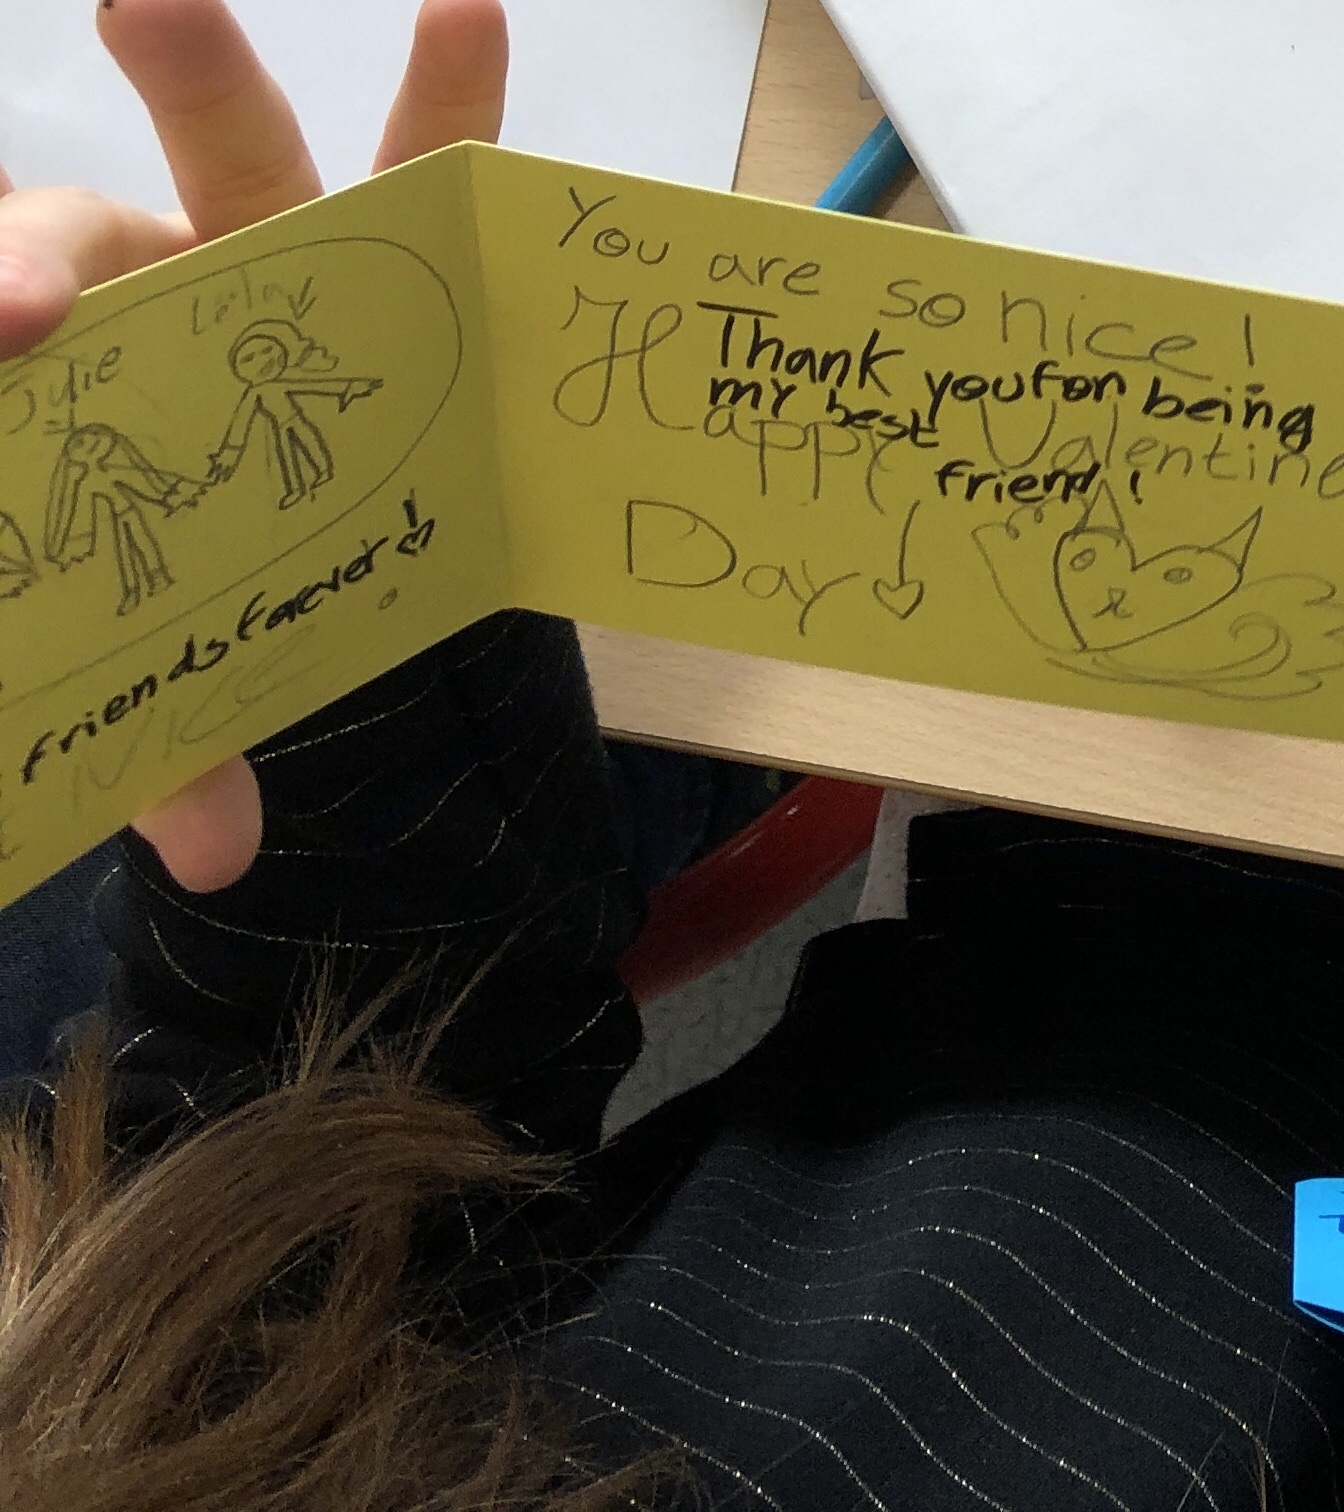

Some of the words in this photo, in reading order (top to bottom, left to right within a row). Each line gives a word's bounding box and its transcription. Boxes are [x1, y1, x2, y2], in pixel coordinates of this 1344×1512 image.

[558, 186, 670, 265] You
[707, 251, 822, 296] are
[877, 278, 967, 328] so
[696, 300, 906, 398] Thank
[924, 368, 1027, 432] you
[1142, 375, 1315, 454] being
[825, 387, 940, 449] best
[934, 458, 1102, 504] friend
[626, 497, 862, 637] Day
